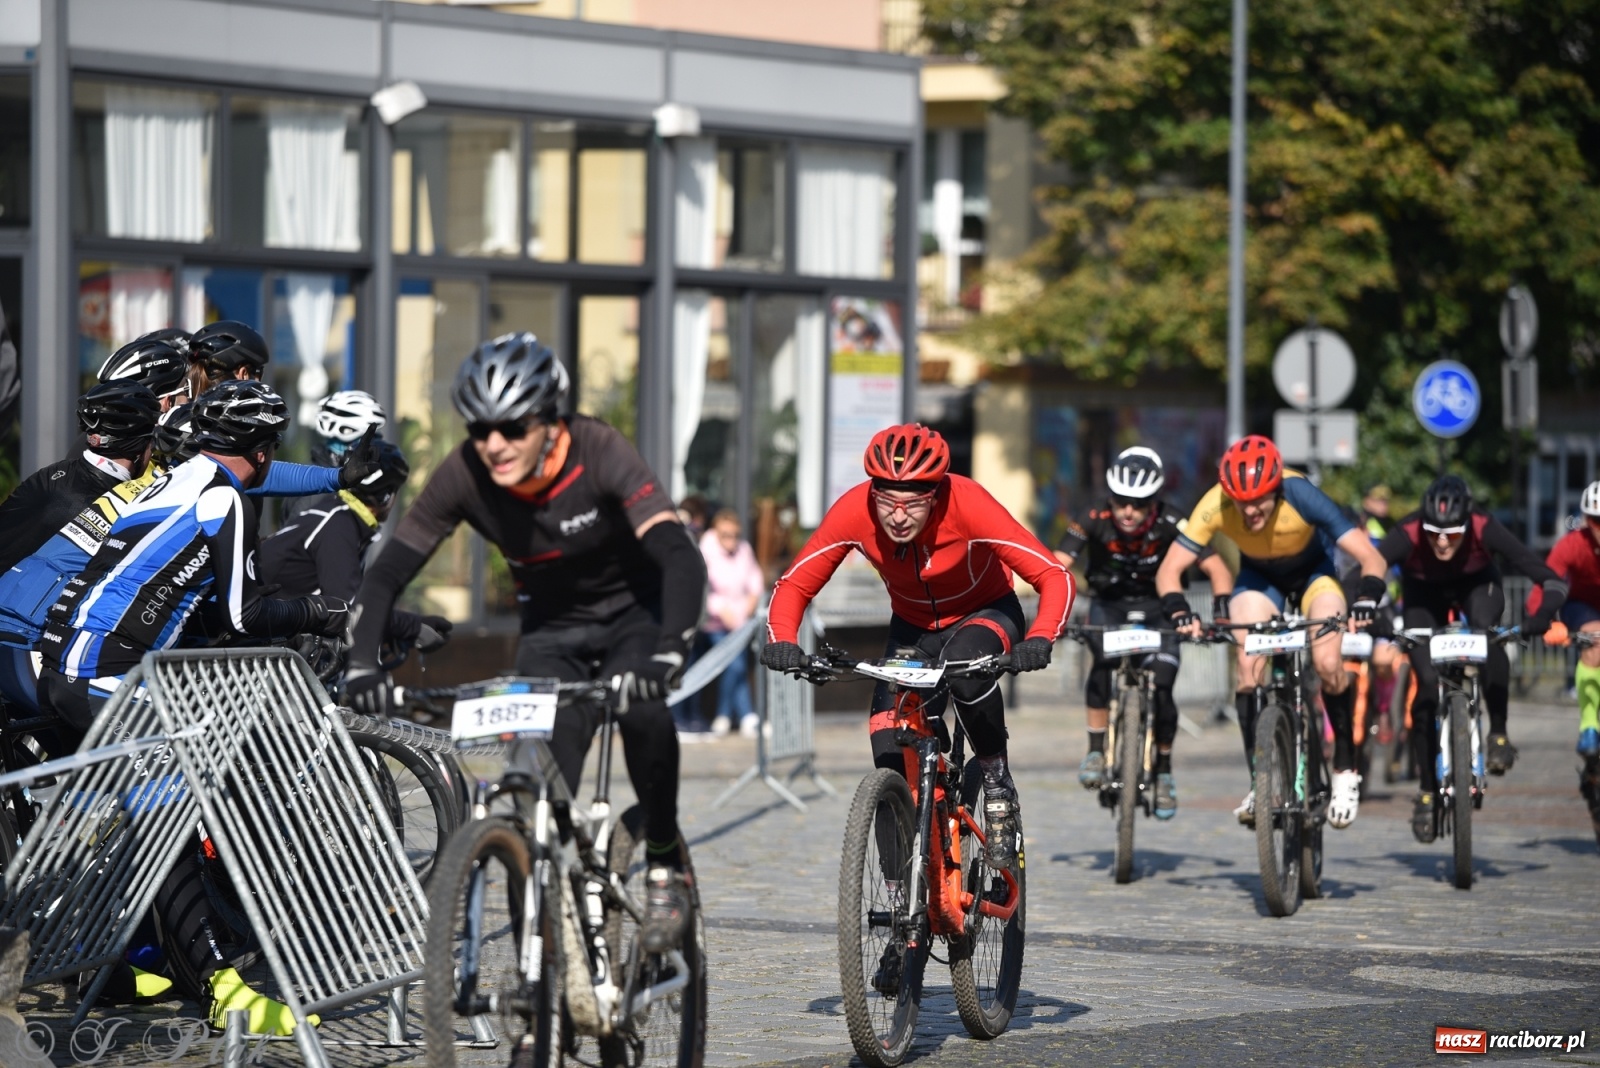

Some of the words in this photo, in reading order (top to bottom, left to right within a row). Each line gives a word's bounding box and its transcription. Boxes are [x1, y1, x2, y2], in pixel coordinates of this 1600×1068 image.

[153, 358, 170, 367] GIRO
[141, 583, 173, 625] GRUPA
[172, 545, 211, 587] MARAT
